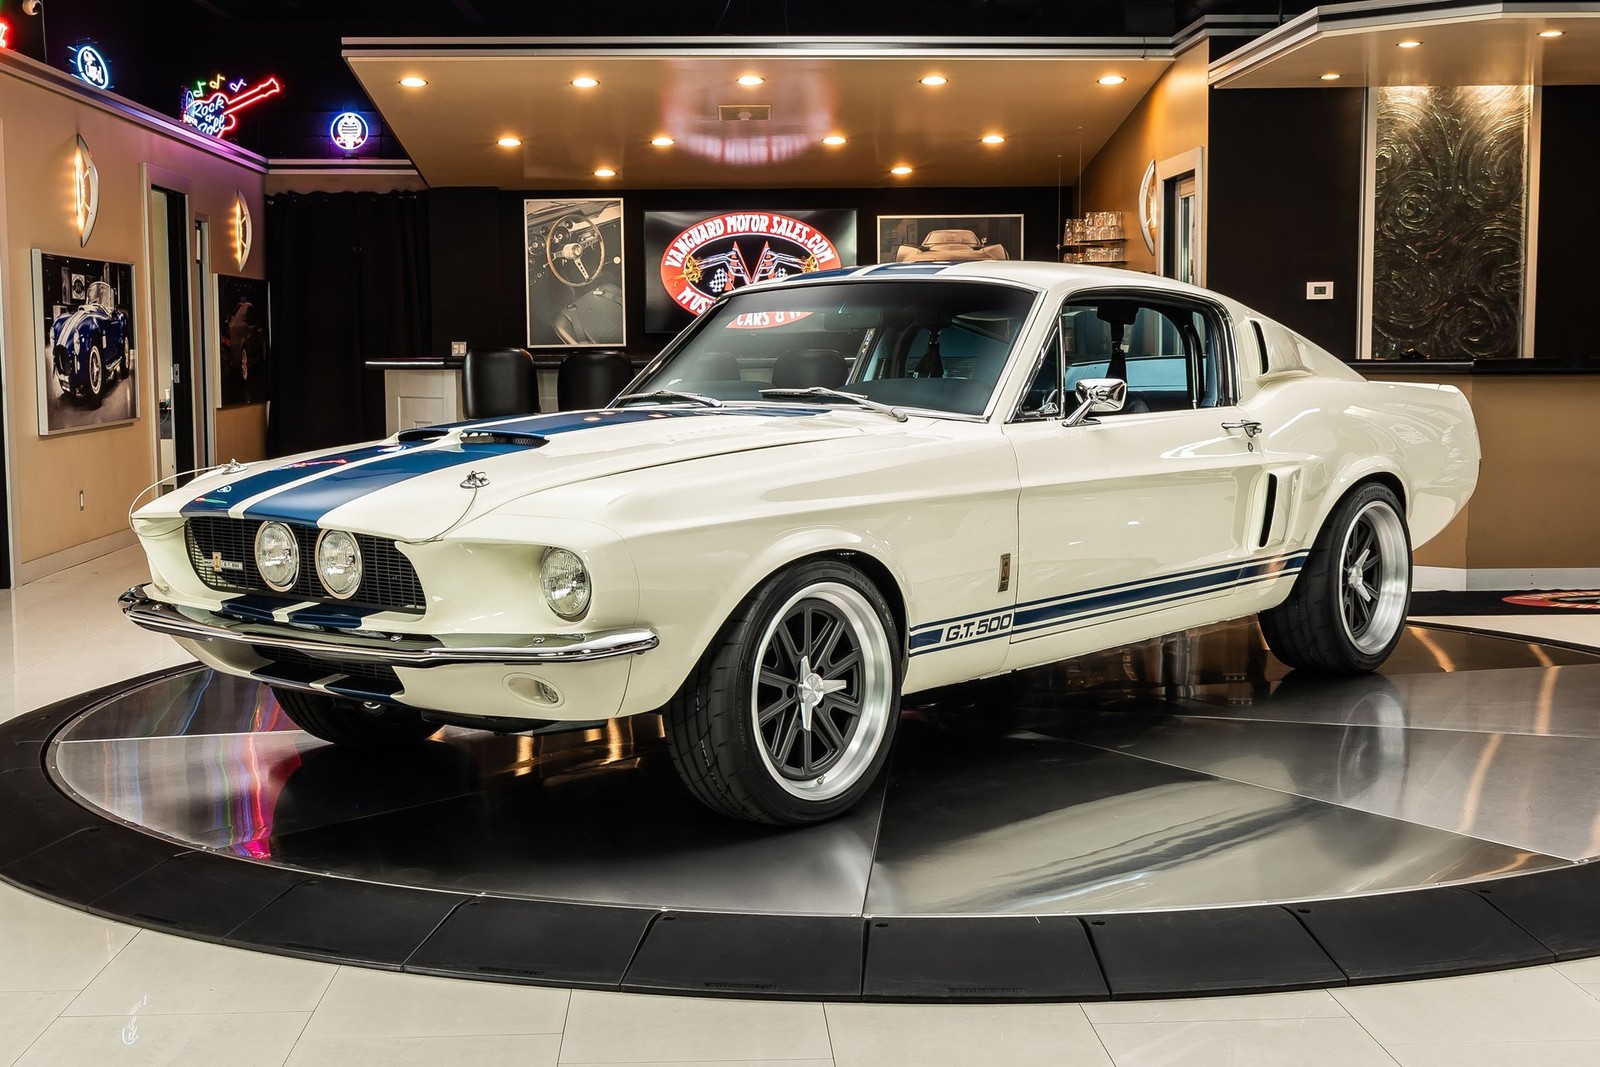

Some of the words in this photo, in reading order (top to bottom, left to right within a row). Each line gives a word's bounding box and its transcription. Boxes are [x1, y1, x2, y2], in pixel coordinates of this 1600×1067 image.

[193, 95, 225, 118] Rock
[665, 218, 725, 268] VANGUARD
[725, 214, 769, 233] MOTOR
[770, 216, 834, 264] SALES.COM
[676, 286, 716, 313] MUS
